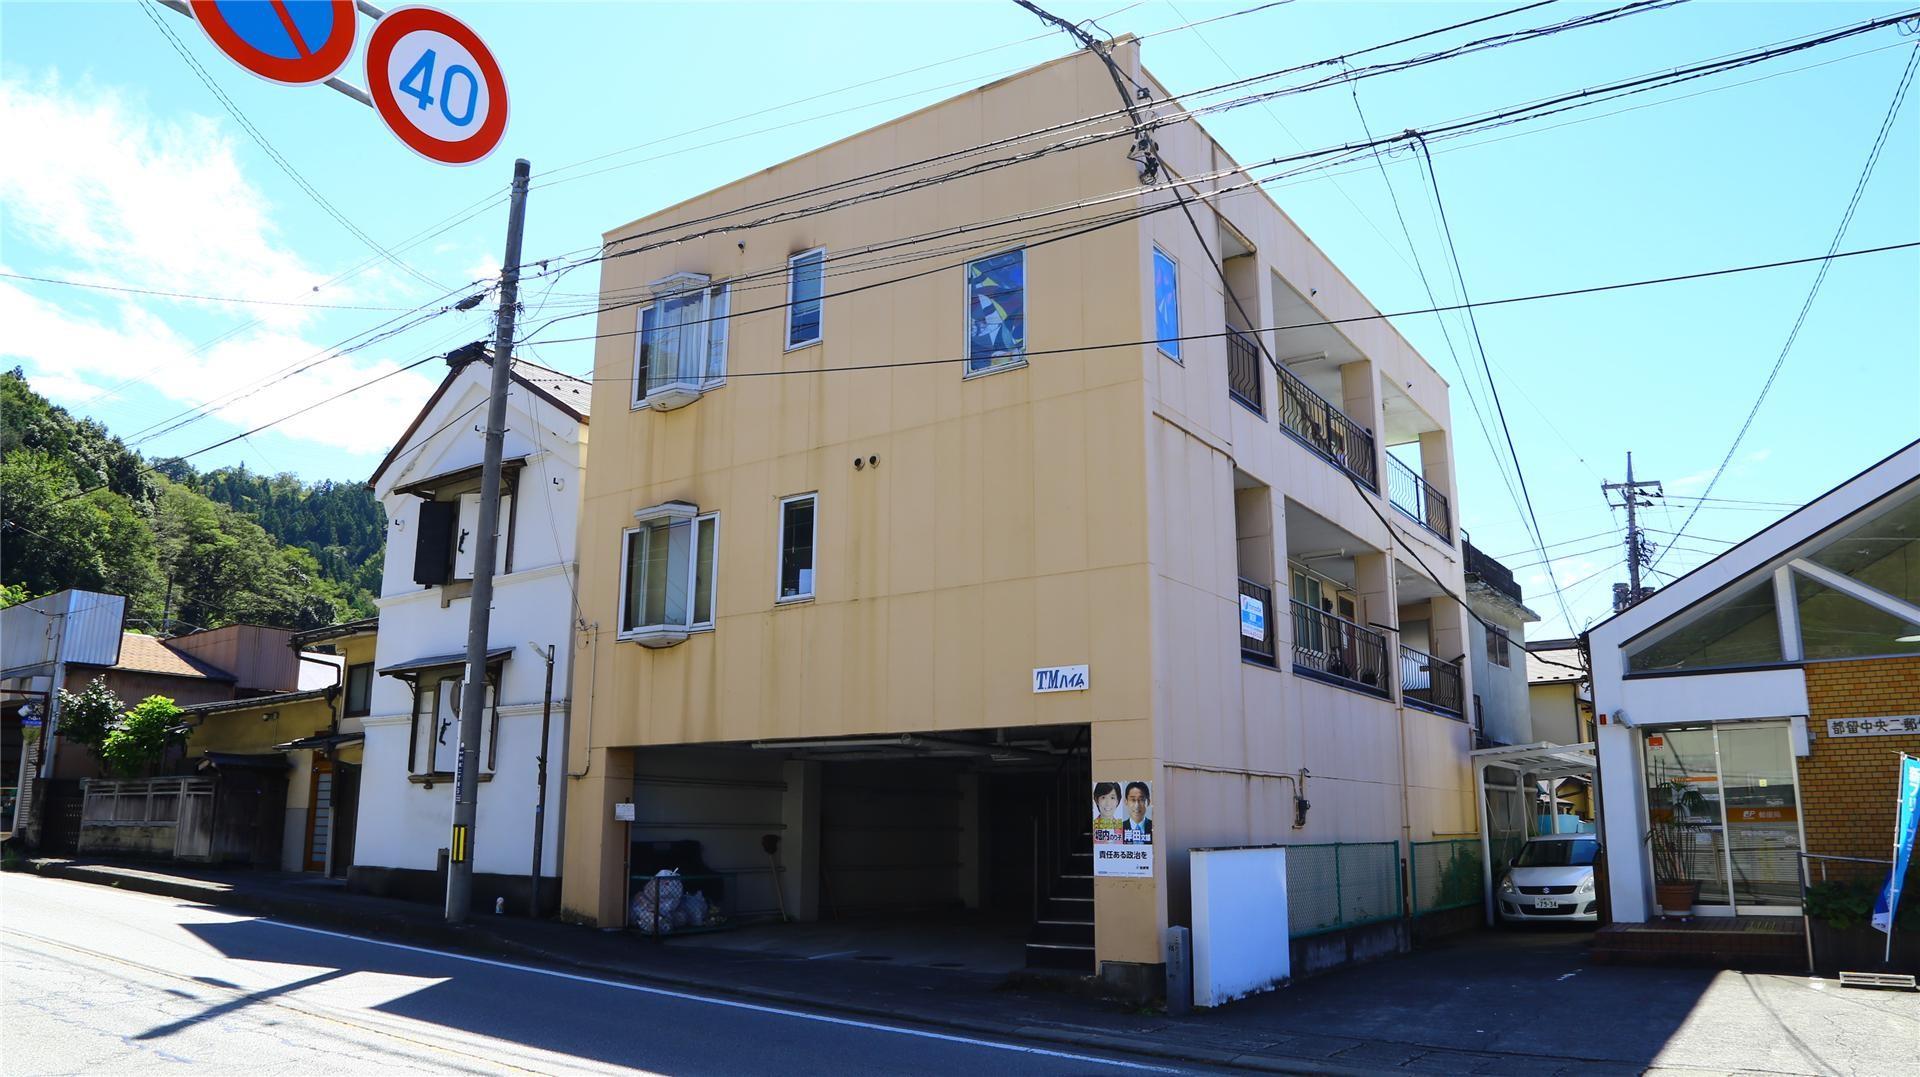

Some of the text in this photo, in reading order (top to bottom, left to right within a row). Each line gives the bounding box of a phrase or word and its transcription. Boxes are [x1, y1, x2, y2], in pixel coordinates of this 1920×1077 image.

[398, 49, 479, 127] 40
[1036, 670, 1085, 690] TMハイム
[1832, 717, 1920, 734] 都留中央二郵
[1099, 850, 1148, 860] 責任ある政治を
